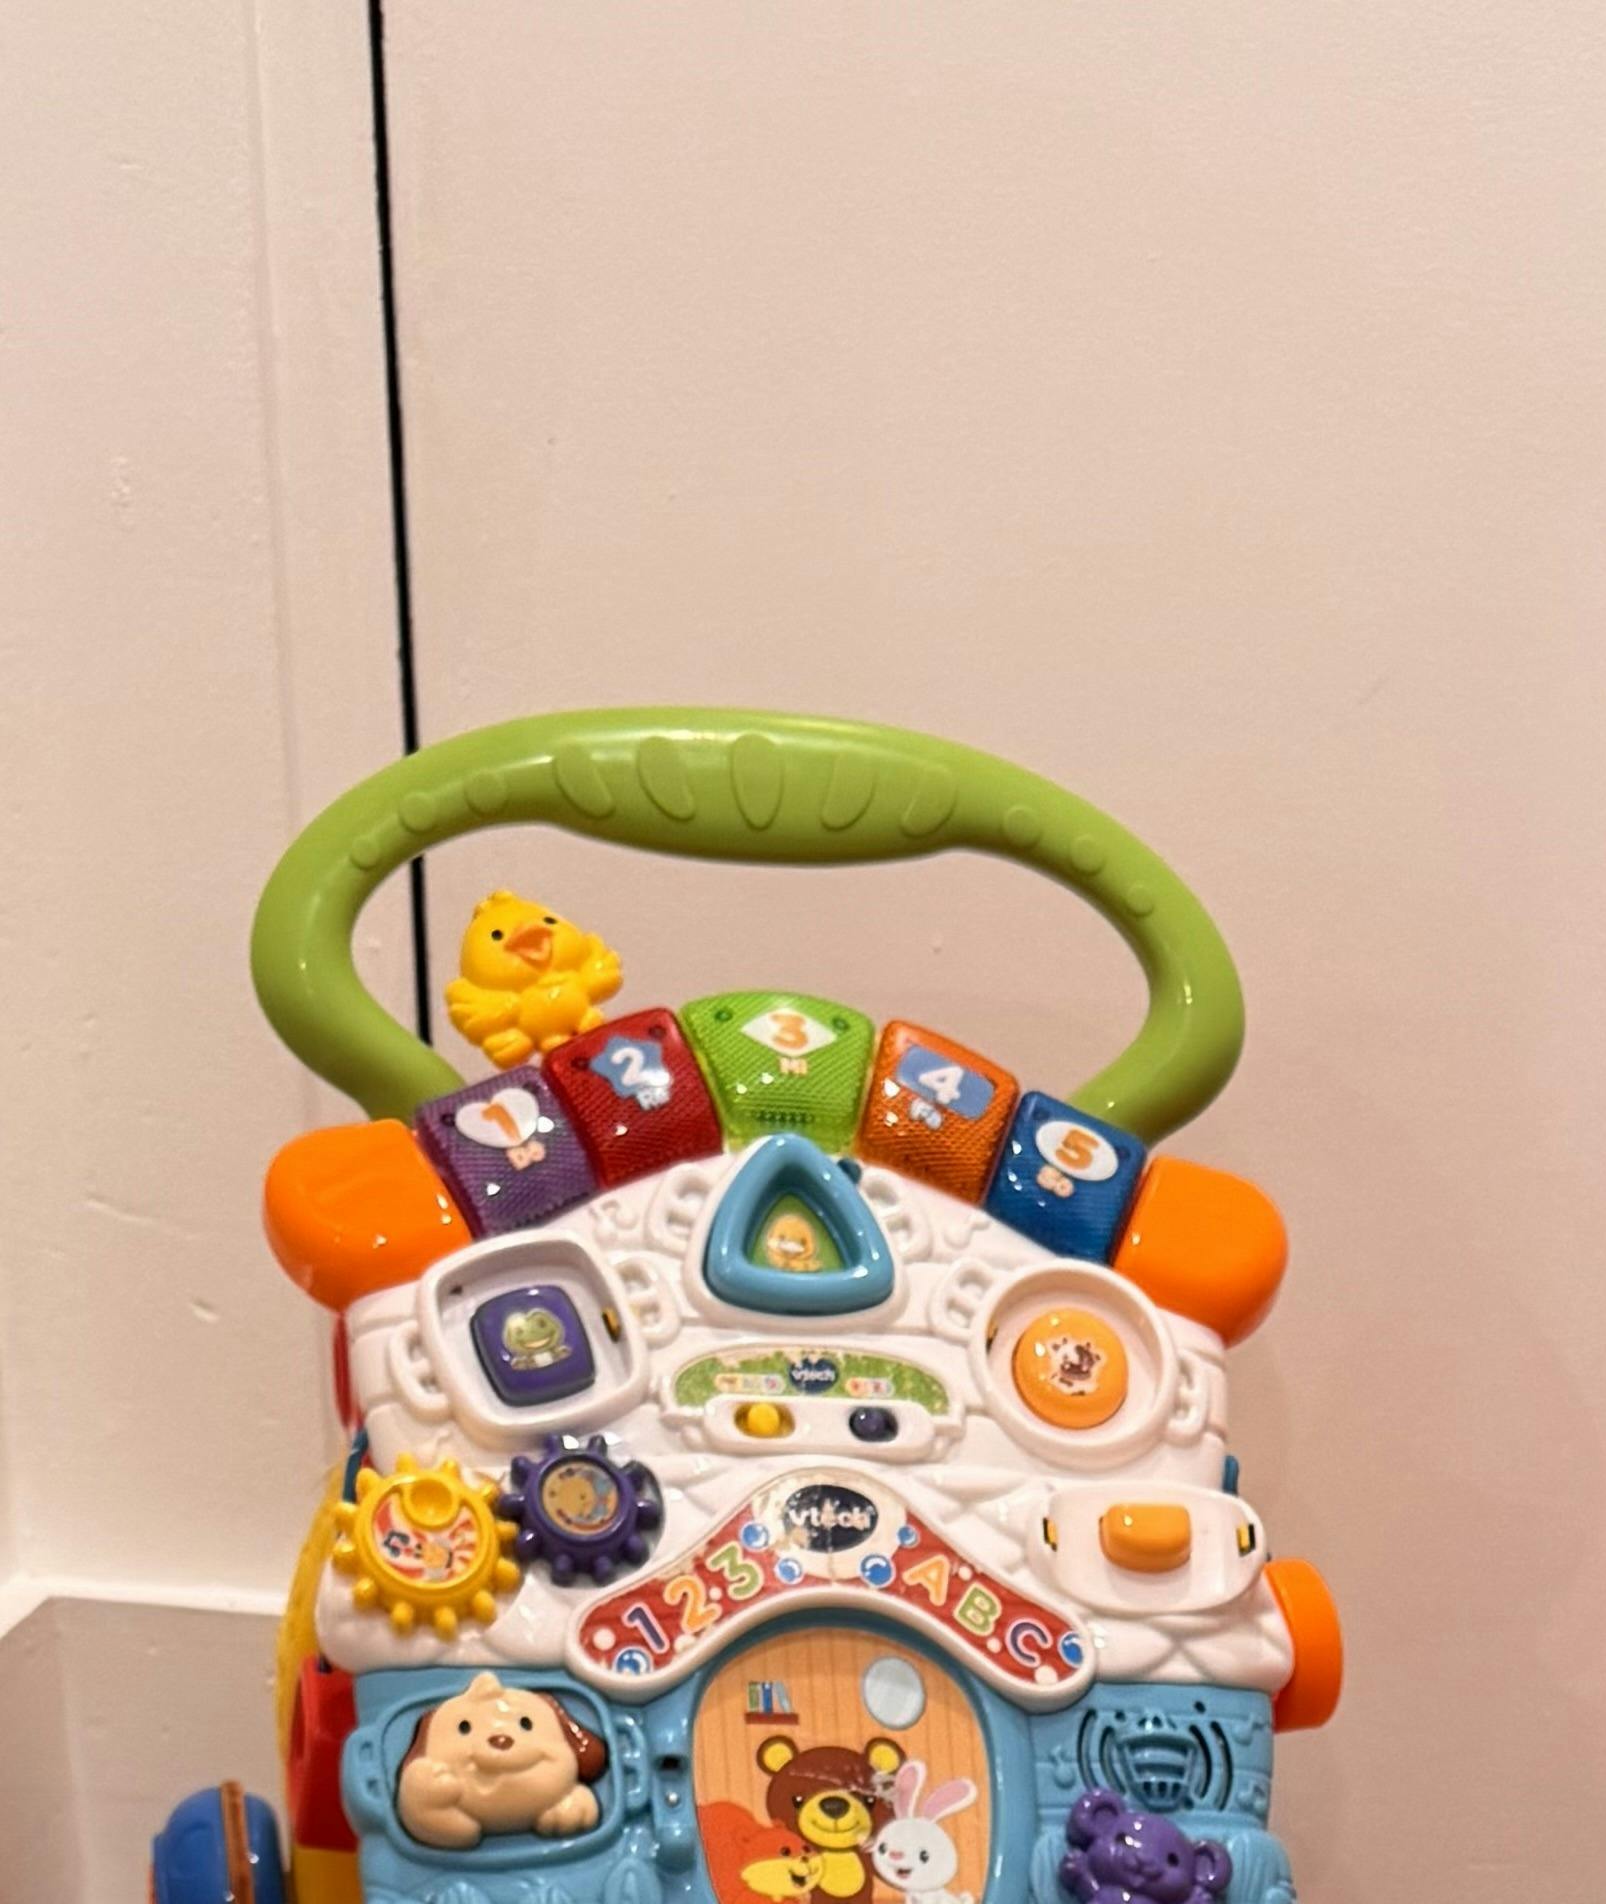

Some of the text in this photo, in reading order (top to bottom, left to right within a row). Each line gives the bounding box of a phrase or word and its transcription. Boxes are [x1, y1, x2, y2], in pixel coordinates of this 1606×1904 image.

[770, 1012, 808, 1049] 3
[612, 1047, 669, 1086] 2
[918, 1065, 964, 1104] 4
[481, 1103, 521, 1143] 1
[1055, 1129, 1099, 1170] 5
